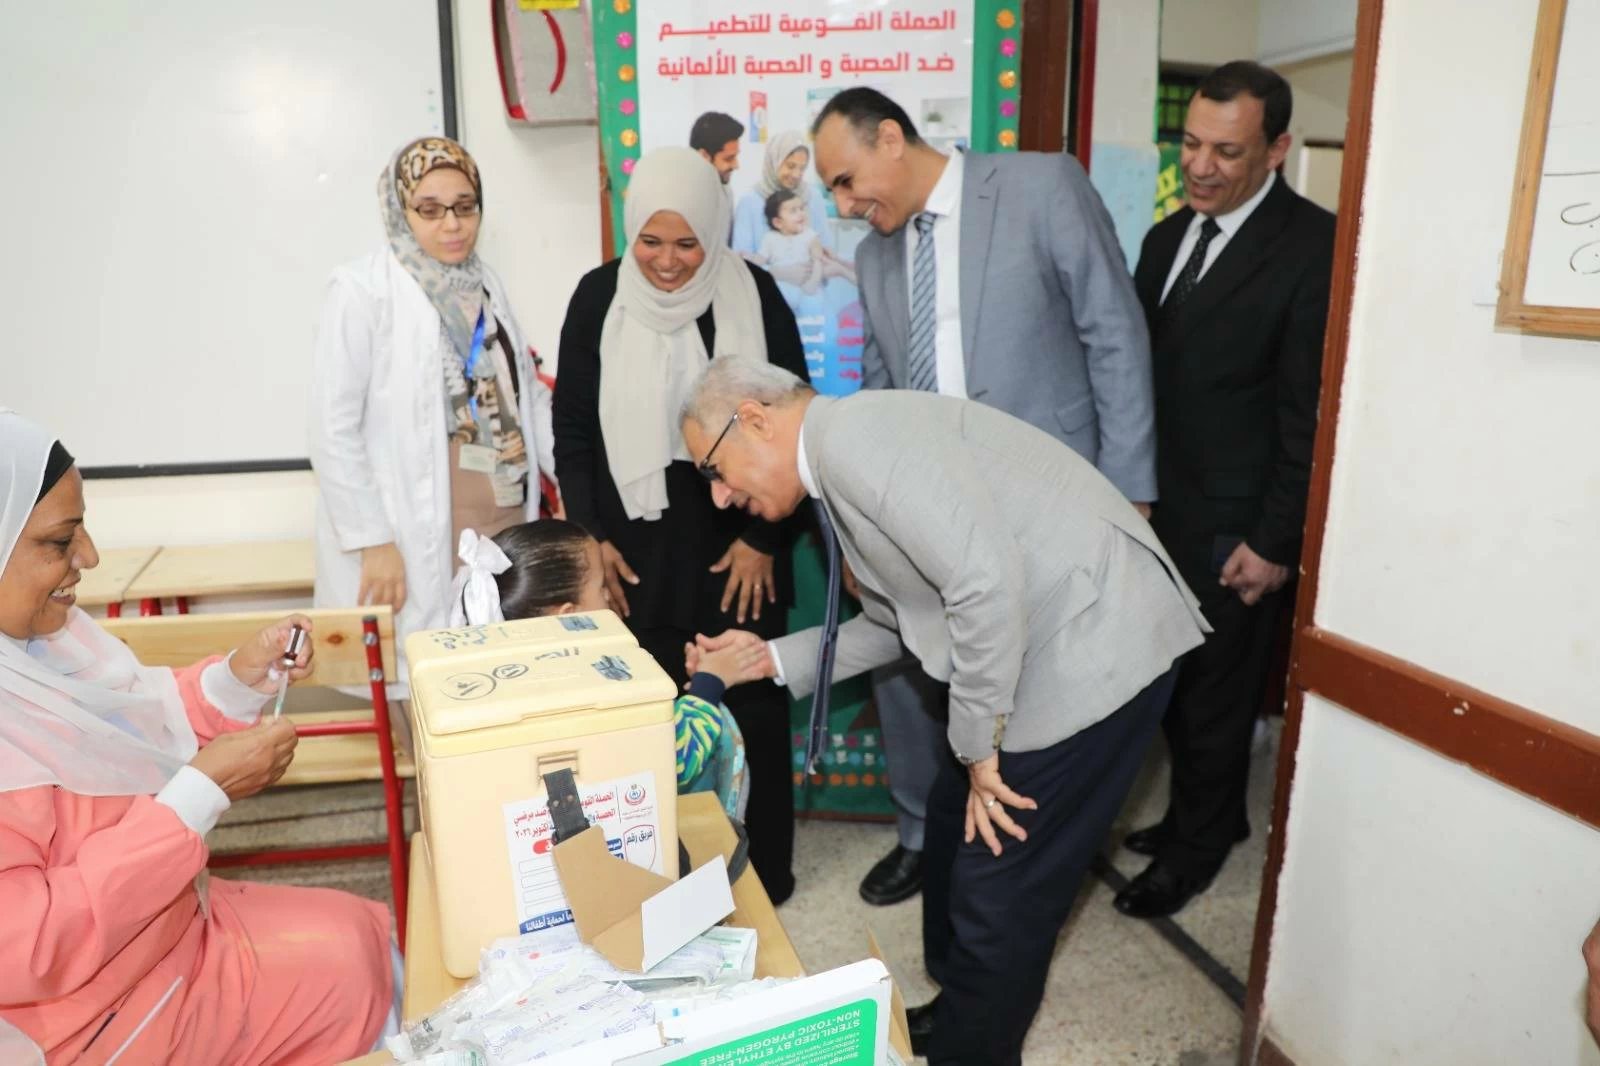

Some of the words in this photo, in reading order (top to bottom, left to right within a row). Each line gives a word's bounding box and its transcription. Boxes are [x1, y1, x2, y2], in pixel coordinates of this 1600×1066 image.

[658, 13, 770, 41] للتطعيم
[779, 10, 882, 38] القومية
[890, 9, 955, 31] الحملة
[657, 47, 736, 81] الألمانية
[744, 53, 812, 80] الحصبة
[820, 59, 832, 79] و
[840, 51, 909, 78] الحصبة
[917, 51, 954, 72] ضد
[794, 1018, 861, 1046] STERILIZED
[798, 1009, 861, 1035] NON-TOXIC
[700, 1030, 796, 1066] PYROGEN-FREE
[775, 1041, 792, 1054] BY
